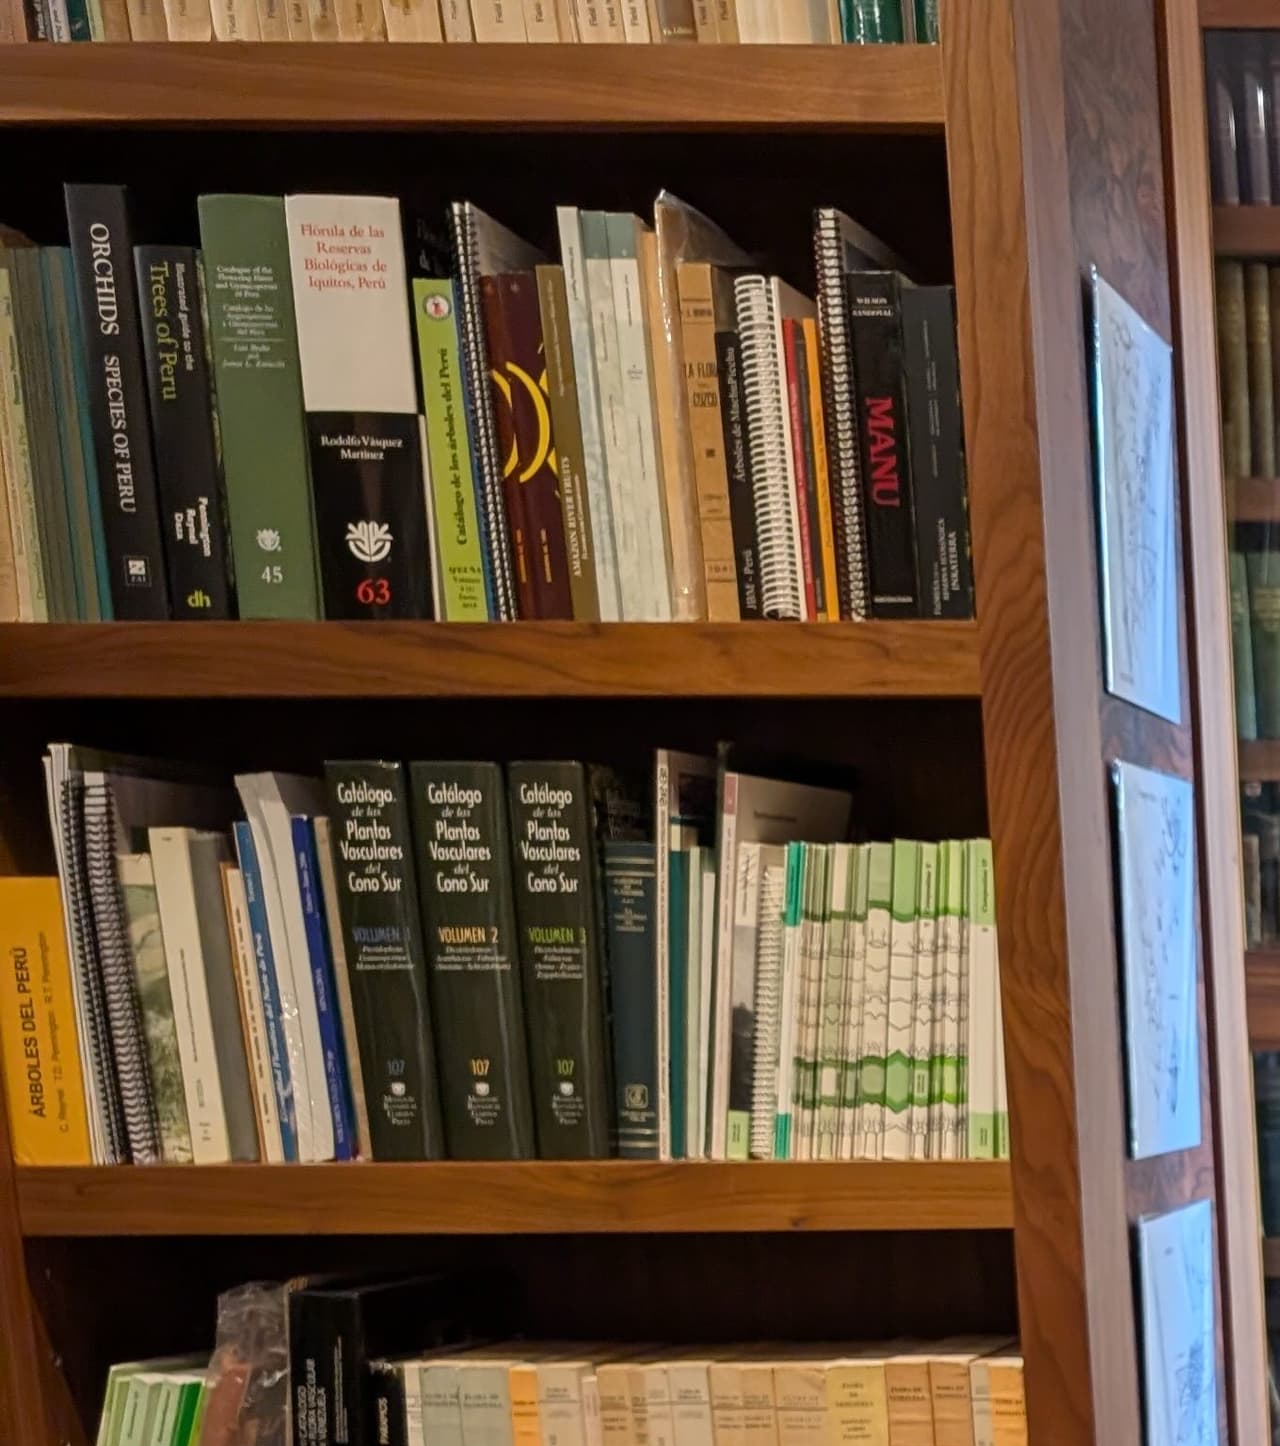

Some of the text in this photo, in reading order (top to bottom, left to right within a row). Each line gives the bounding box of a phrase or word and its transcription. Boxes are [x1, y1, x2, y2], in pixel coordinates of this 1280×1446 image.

[300, 223, 385, 238] Flórula de las
[316, 241, 372, 255] Reservas
[304, 258, 388, 273] Biológicas de
[308, 276, 387, 291] Iquitos, Perú
[150, 260, 179, 401] Trees of Peru
[89, 222, 136, 513] ORCHIDS SPECIES OF PERU
[320, 434, 361, 448] Rodolfo
[439, 348, 468, 545] Catálogo de los árboles del Perú
[865, 397, 900, 508] MANU
[560, 455, 583, 578] AMAZON RIVER FRUITS
[261, 565, 284, 584] 45
[187, 590, 212, 608] dh
[356, 577, 392, 606] 63
[428, 781, 482, 808] Catálogo
[520, 781, 573, 809] Catálogo
[441, 807, 454, 817] de
[532, 807, 545, 817] de
[436, 819, 480, 841] Plantas
[527, 819, 570, 841] Plantas
[429, 840, 491, 861] Vasculares
[521, 840, 580, 861] Vasculares
[454, 863, 469, 875] del
[543, 863, 559, 875] del
[437, 872, 489, 893] Cono Sur
[527, 872, 578, 893] Cono Sur
[438, 927, 485, 943] VOLUMEN
[528, 927, 574, 943] VOLUMEN
[9, 946, 46, 1119] ÁRBOLES DEL PERÚ
[471, 1059, 490, 1076] 107
[557, 1059, 575, 1076] 107
